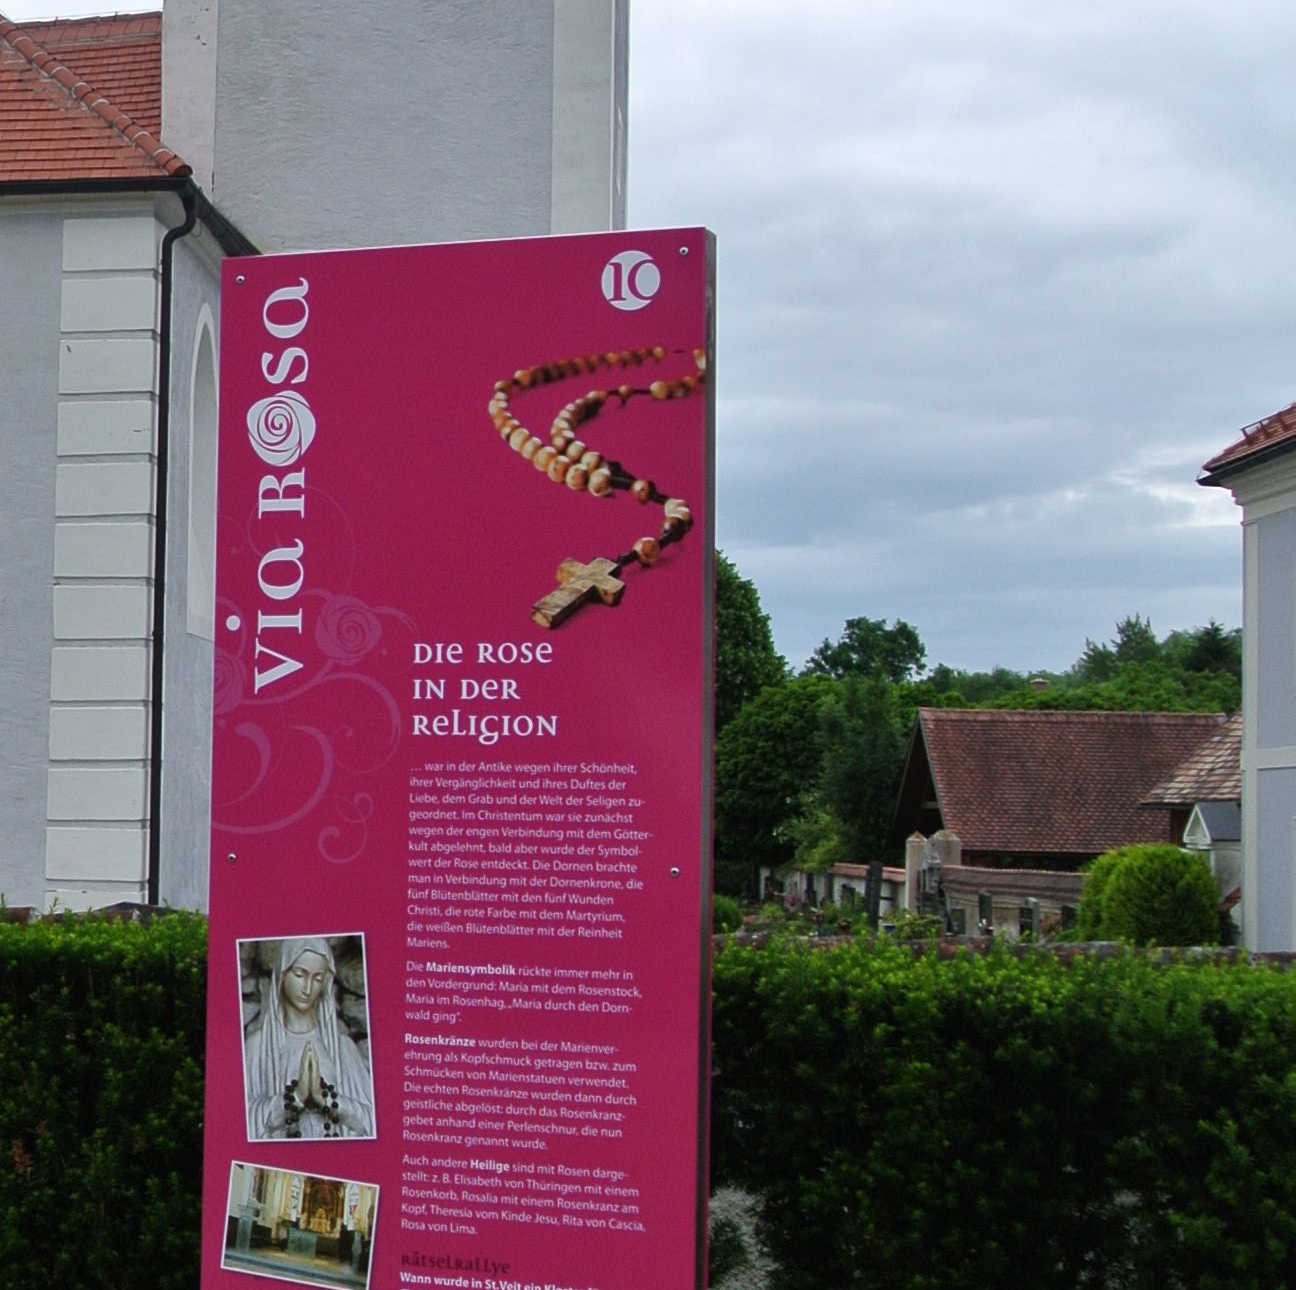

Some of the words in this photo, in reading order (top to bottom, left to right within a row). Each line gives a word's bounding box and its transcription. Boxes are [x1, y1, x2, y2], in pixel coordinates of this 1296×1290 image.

[424, 763, 443, 771] war
[458, 761, 475, 771] der
[478, 761, 512, 771] Antike
[514, 764, 550, 774] wegen
[553, 762, 577, 772] ihrer
[409, 777, 433, 787] ihrer
[435, 777, 515, 790] Vergänglichkeit
[518, 778, 539, 788] und
[542, 778, 567, 788] ihres
[570, 778, 605, 789] Duftes
[607, 779, 626, 789] der
[442, 793, 465, 803] dem
[468, 794, 493, 803] Grab
[496, 794, 516, 804] und
[519, 795, 537, 804] der
[538, 795, 562, 805] Welt
[565, 795, 583, 805] der
[586, 795, 625, 808] Seligen
[461, 810, 475, 819] Im
[477, 809, 542, 820] Christentum
[545, 813, 564, 821] war
[584, 812, 632, 822] zunächst
[408, 840, 427, 850] kult
[488, 842, 511, 852] bald
[514, 843, 538, 853] aber
[540, 844, 574, 854] wurde
[576, 844, 594, 854] der
[408, 858, 431, 867] wert
[434, 857, 451, 867] der
[454, 857, 478, 868] Rose
[532, 859, 550, 870] Die
[553, 860, 593, 871] Dornen
[595, 861, 637, 872] brachte
[433, 874, 443, 883] in
[445, 873, 506, 887] Verbindung
[509, 876, 526, 885] mit
[529, 876, 547, 886] der
[626, 878, 643, 889] die
[444, 906, 461, 916] die
[463, 908, 484, 917] rote
[487, 907, 516, 917] Farbe
[519, 910, 536, 918] mit
[539, 909, 563, 919] dem
[406, 920, 423, 931] die
[425, 921, 463, 931] weißen
[465, 922, 534, 934] Blütenblätter
[537, 926, 554, 935] mit
[557, 926, 575, 936] der
[578, 926, 622, 938] Reinheit
[406, 961, 423, 971] Die
[426, 961, 515, 975] Mariensymbolik
[518, 967, 551, 976] rückte
[554, 969, 588, 977] immer
[591, 969, 619, 979] mehr
[623, 971, 632, 979] in
[405, 977, 425, 987] den
[499, 981, 528, 991] Maria
[531, 983, 548, 992] mit
[551, 983, 575, 994] dem
[404, 1033, 475, 1045] Rosenkränze
[478, 1038, 518, 1048] wurden
[521, 1039, 537, 1049] bei
[540, 1041, 557, 1050] der
[404, 1049, 441, 1062] ehrung
[444, 1051, 458, 1061] als
[460, 1052, 531, 1066] Kopfschmuck
[534, 1058, 582, 1070] getragen
[612, 1062, 636, 1071] zum
[404, 1065, 464, 1077] Schmücken
[466, 1071, 486, 1079] von
[488, 1070, 565, 1084] Marienstatuen
[404, 1081, 421, 1091] Die
[423, 1083, 459, 1094] echten
[462, 1084, 528, 1097] Rosenkränze
[530, 1089, 572, 1100] wurden
[574, 1091, 602, 1102] dann
[604, 1093, 636, 1104] durch
[403, 1129, 462, 1142] Rosenkranz
[464, 1136, 508, 1147] genannt
[402, 1154, 428, 1164] Auch
[431, 1156, 467, 1167] andere
[470, 1158, 509, 1172] Heilige
[512, 1162, 534, 1172] sind
[537, 1165, 554, 1174] mit
[557, 1165, 589, 1175] Rosen
[461, 1190, 497, 1202] Rosalia
[500, 1195, 518, 1204] mit
[520, 1195, 554, 1206] einem
[556, 1197, 619, 1211] Rosenkranz
[621, 1205, 638, 1213] am
[430, 1204, 472, 1216] Theresia
[475, 1210, 498, 1219] vom
[501, 1210, 531, 1221] Kinde
[562, 1214, 582, 1225] Rita
[585, 1218, 605, 1227] von
[400, 1271, 431, 1282] Wann
[433, 1274, 468, 1286] wurde
[471, 1278, 482, 1287] in
